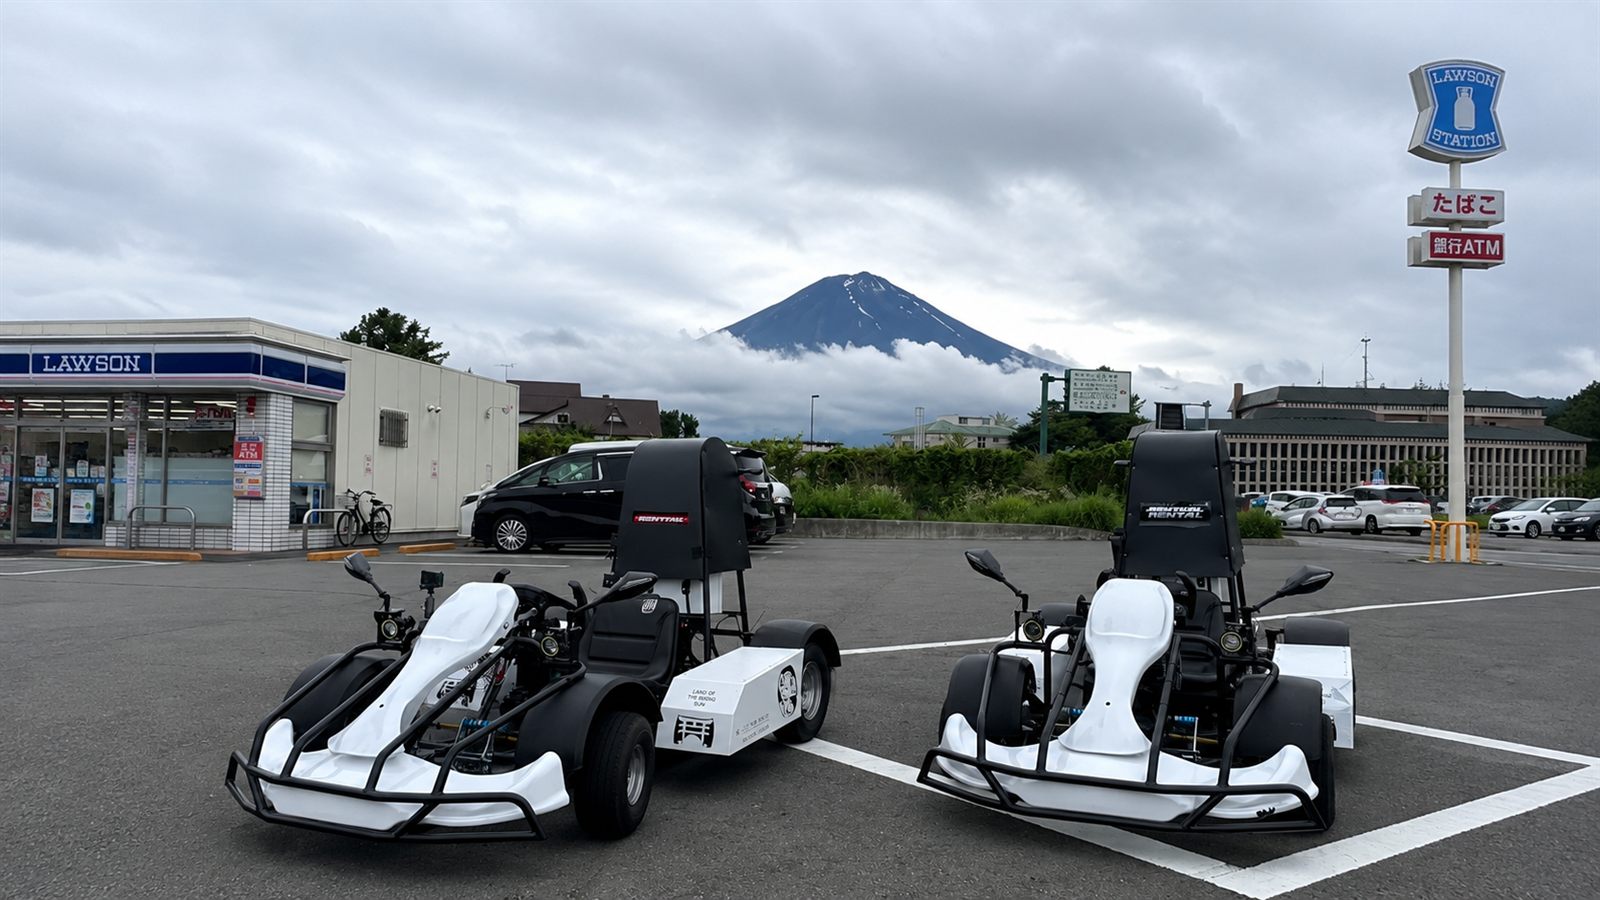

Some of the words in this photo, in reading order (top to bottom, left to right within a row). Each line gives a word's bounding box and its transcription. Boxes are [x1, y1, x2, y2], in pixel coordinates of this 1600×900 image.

[1432, 69, 1497, 88] LAWSON
[1431, 128, 1498, 149] STATION
[1432, 192, 1497, 215] たばこ
[42, 354, 141, 372] LAWSON
